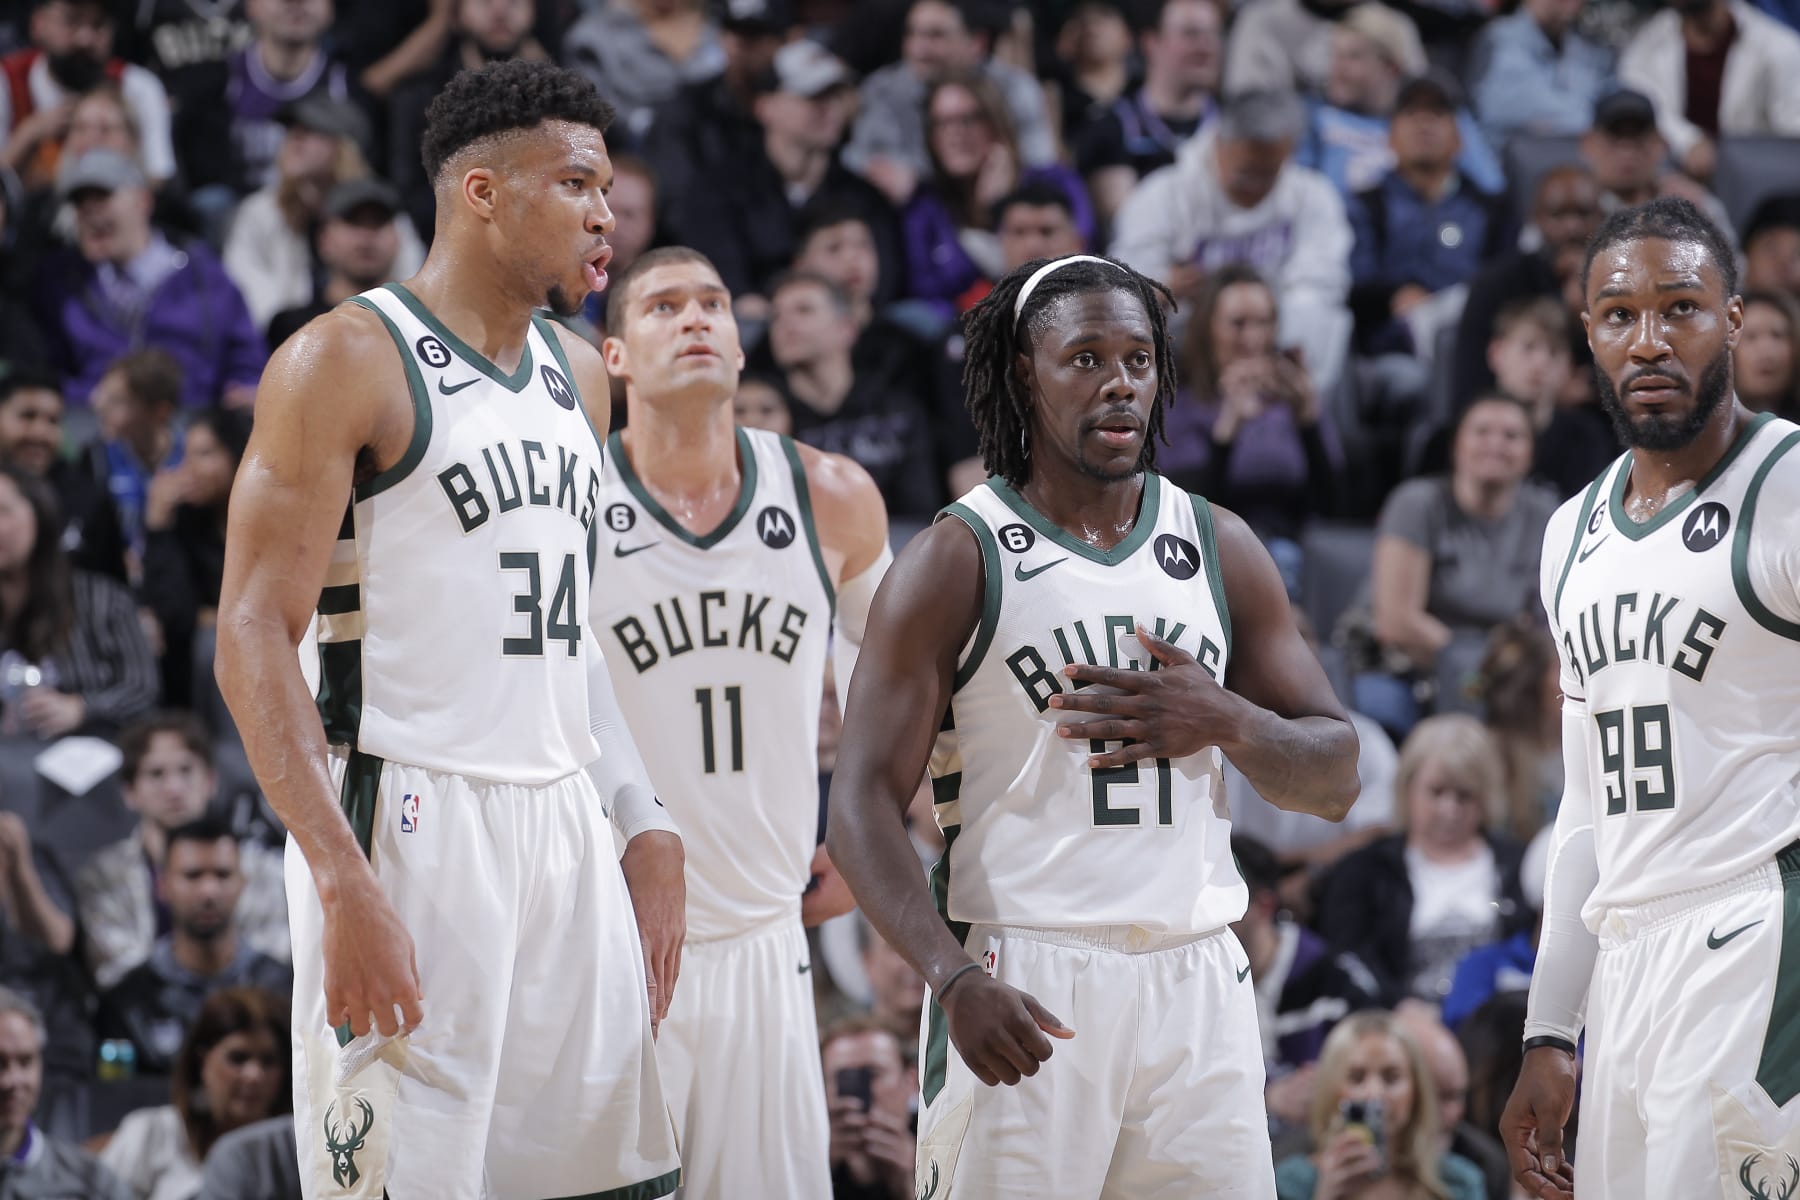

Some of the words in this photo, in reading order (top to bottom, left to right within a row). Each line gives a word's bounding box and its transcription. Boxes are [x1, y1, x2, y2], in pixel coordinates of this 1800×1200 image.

[422, 340, 446, 365] 6
[436, 439, 600, 535] BUCKS
[611, 507, 631, 530] 6
[1004, 528, 1028, 550] 6
[498, 550, 582, 659] 34
[611, 589, 808, 675] BUCKS
[1563, 590, 1728, 689] BUCKS
[695, 686, 744, 774] 11
[1594, 702, 1677, 817] 99
[1089, 737, 1175, 829] 21
